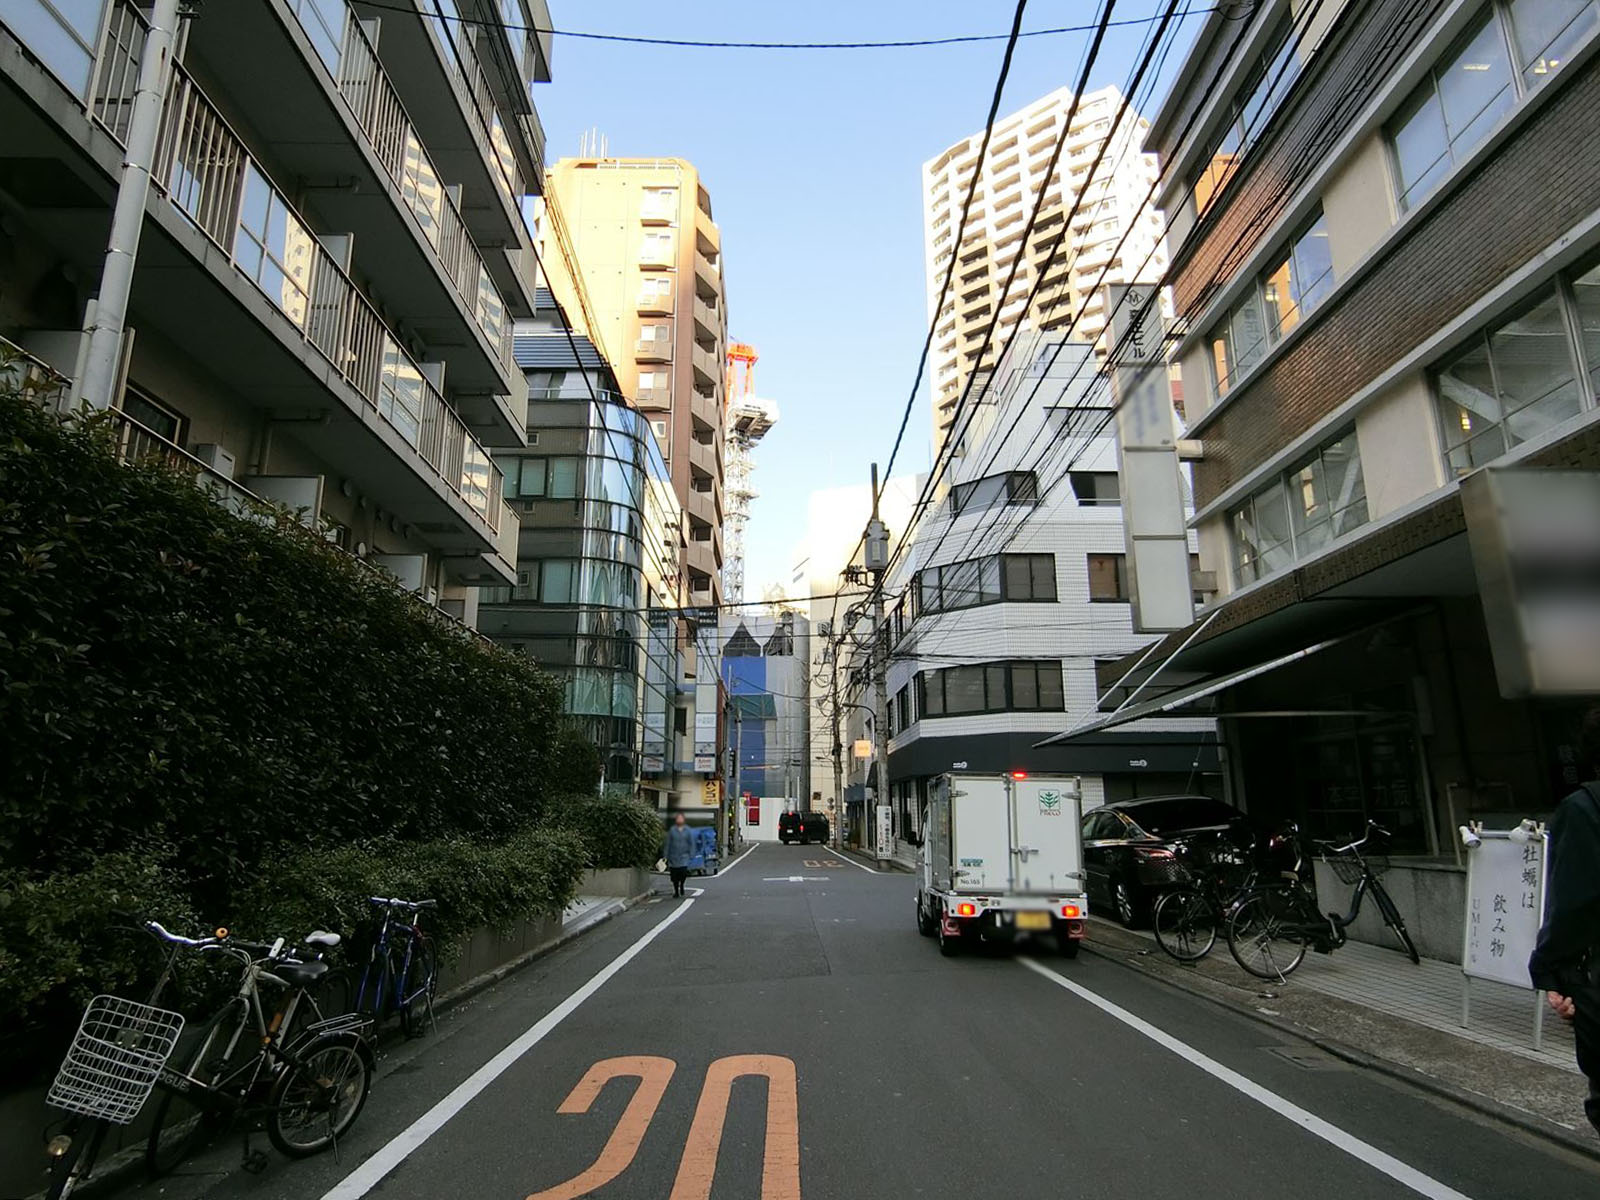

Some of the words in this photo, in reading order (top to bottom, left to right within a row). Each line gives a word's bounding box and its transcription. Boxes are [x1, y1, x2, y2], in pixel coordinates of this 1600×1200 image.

[1521, 845, 1539, 909] 牡蠣は
[1490, 894, 1507, 957] 飲み物
[526, 1054, 801, 1200] 20
